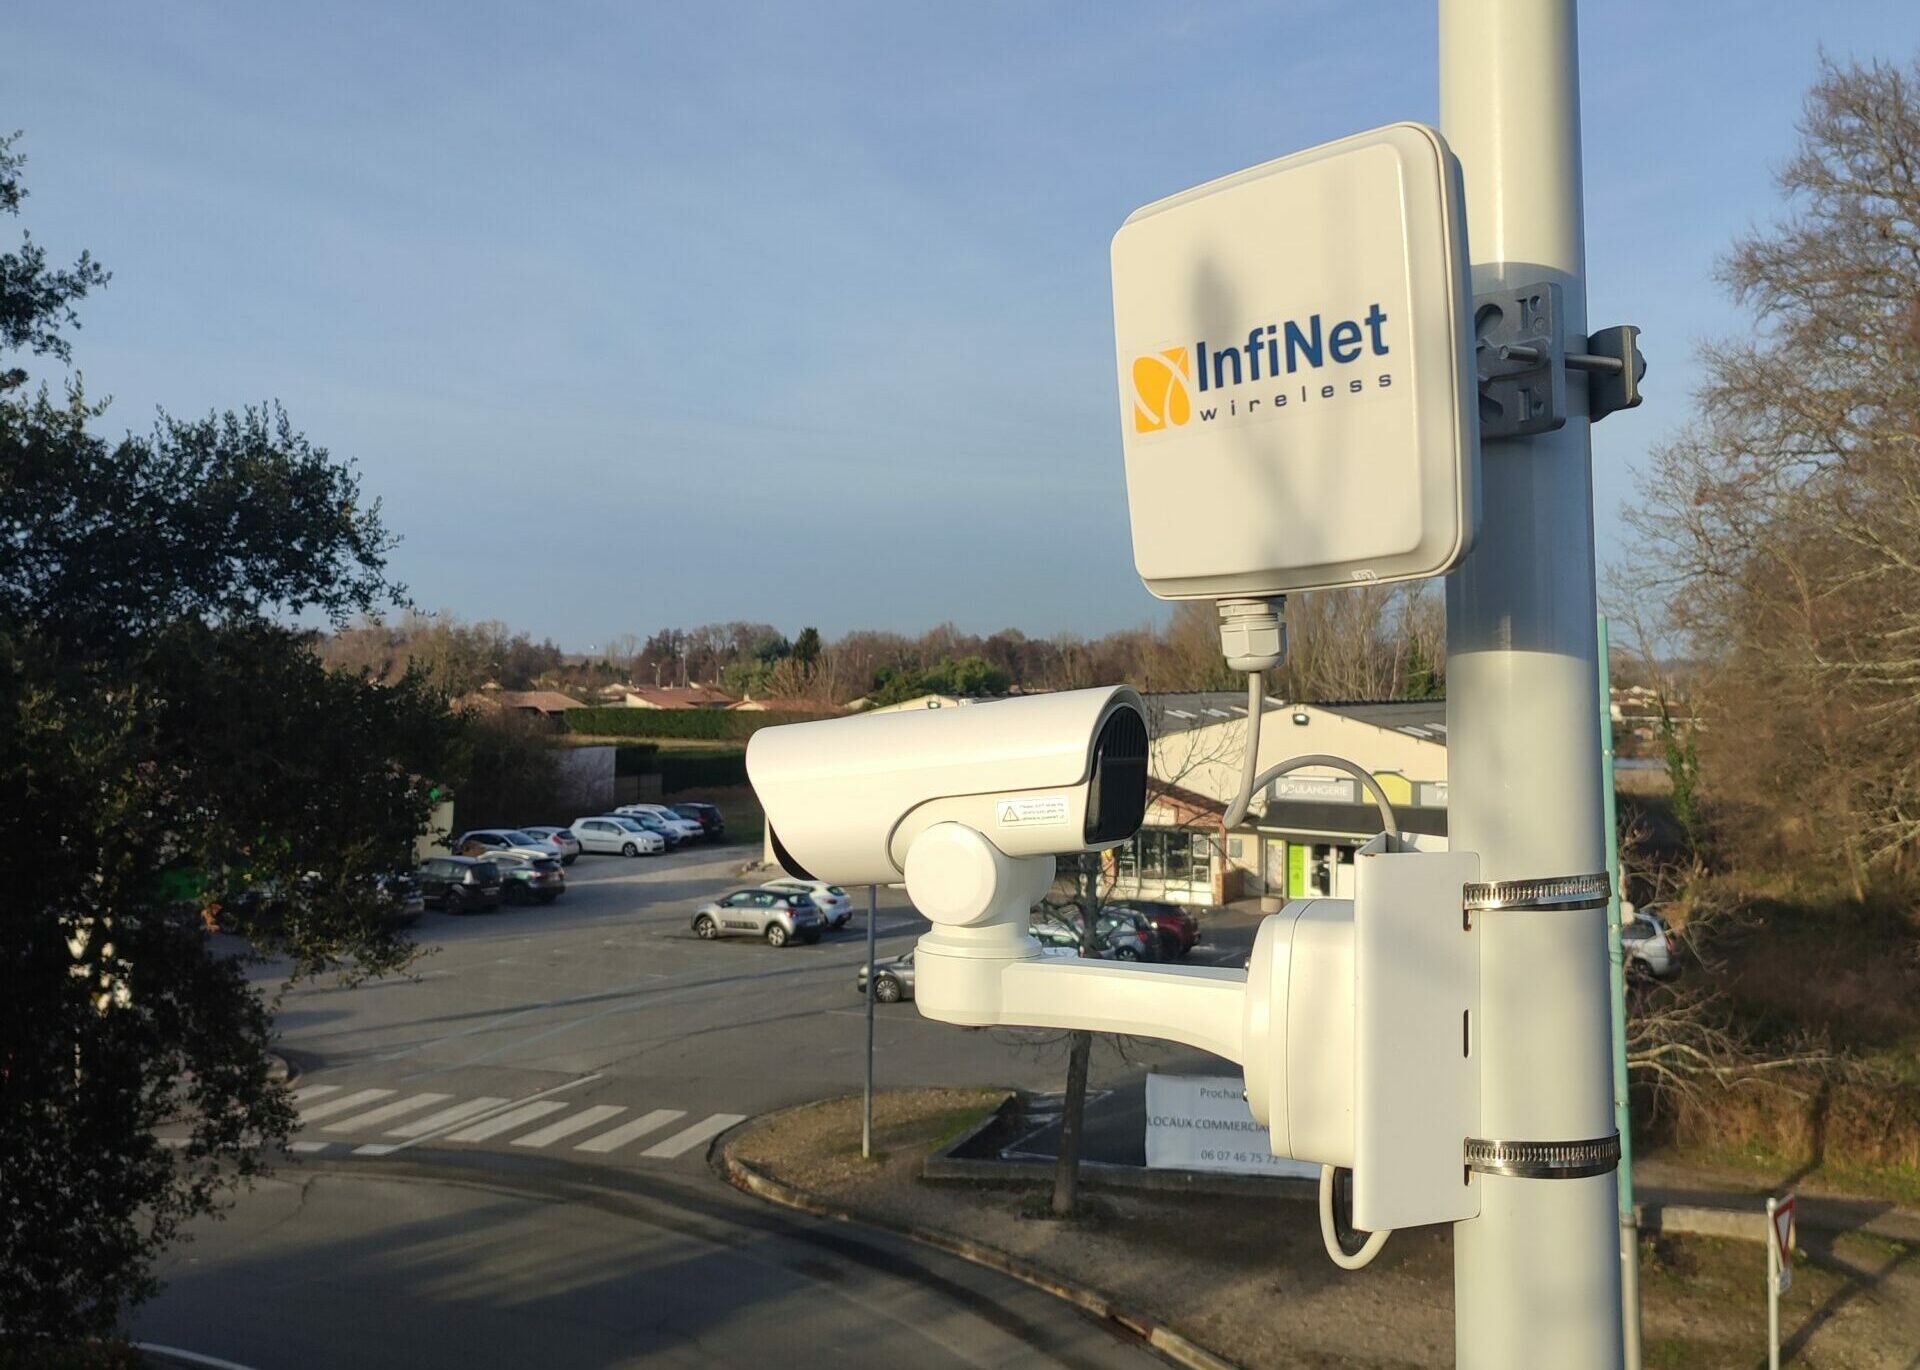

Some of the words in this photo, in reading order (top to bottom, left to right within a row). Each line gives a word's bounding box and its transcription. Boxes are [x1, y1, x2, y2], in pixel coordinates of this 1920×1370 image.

[1197, 303, 1389, 392] InfiNet
[1200, 374, 1392, 421] wireless
[1281, 784, 1349, 797] BOULANGERIE
[1147, 1116, 1192, 1128] LOCAUX
[1200, 1150, 1214, 1160] 06
[1217, 1150, 1230, 1161] 07
[1233, 1151, 1247, 1162] 46
[1249, 1153, 1262, 1163] 75
